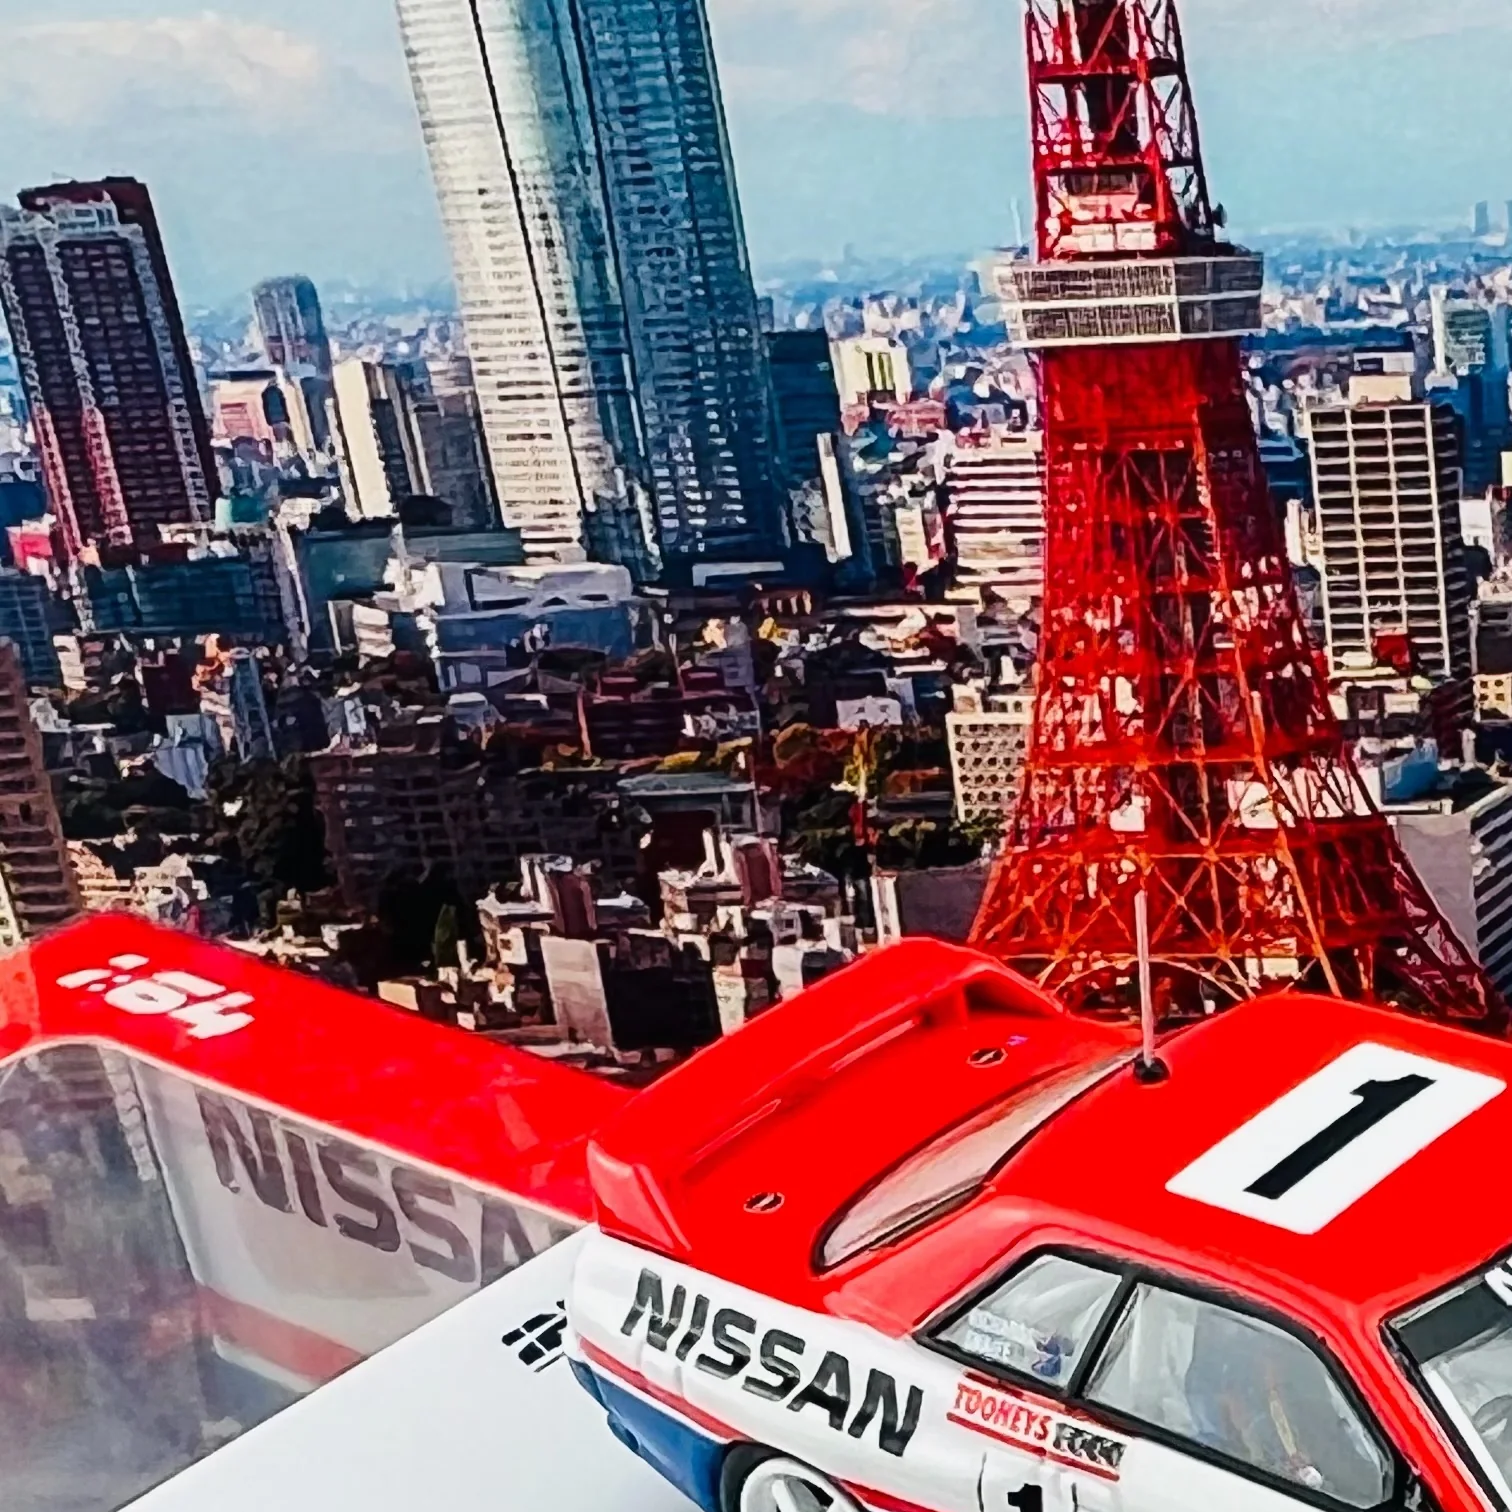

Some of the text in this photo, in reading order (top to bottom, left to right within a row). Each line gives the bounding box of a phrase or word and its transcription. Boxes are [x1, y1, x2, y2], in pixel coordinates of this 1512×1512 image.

[195, 1087, 578, 1288] NISSA
[1243, 1074, 1436, 1200] 1
[620, 1267, 924, 1457] NISSAN
